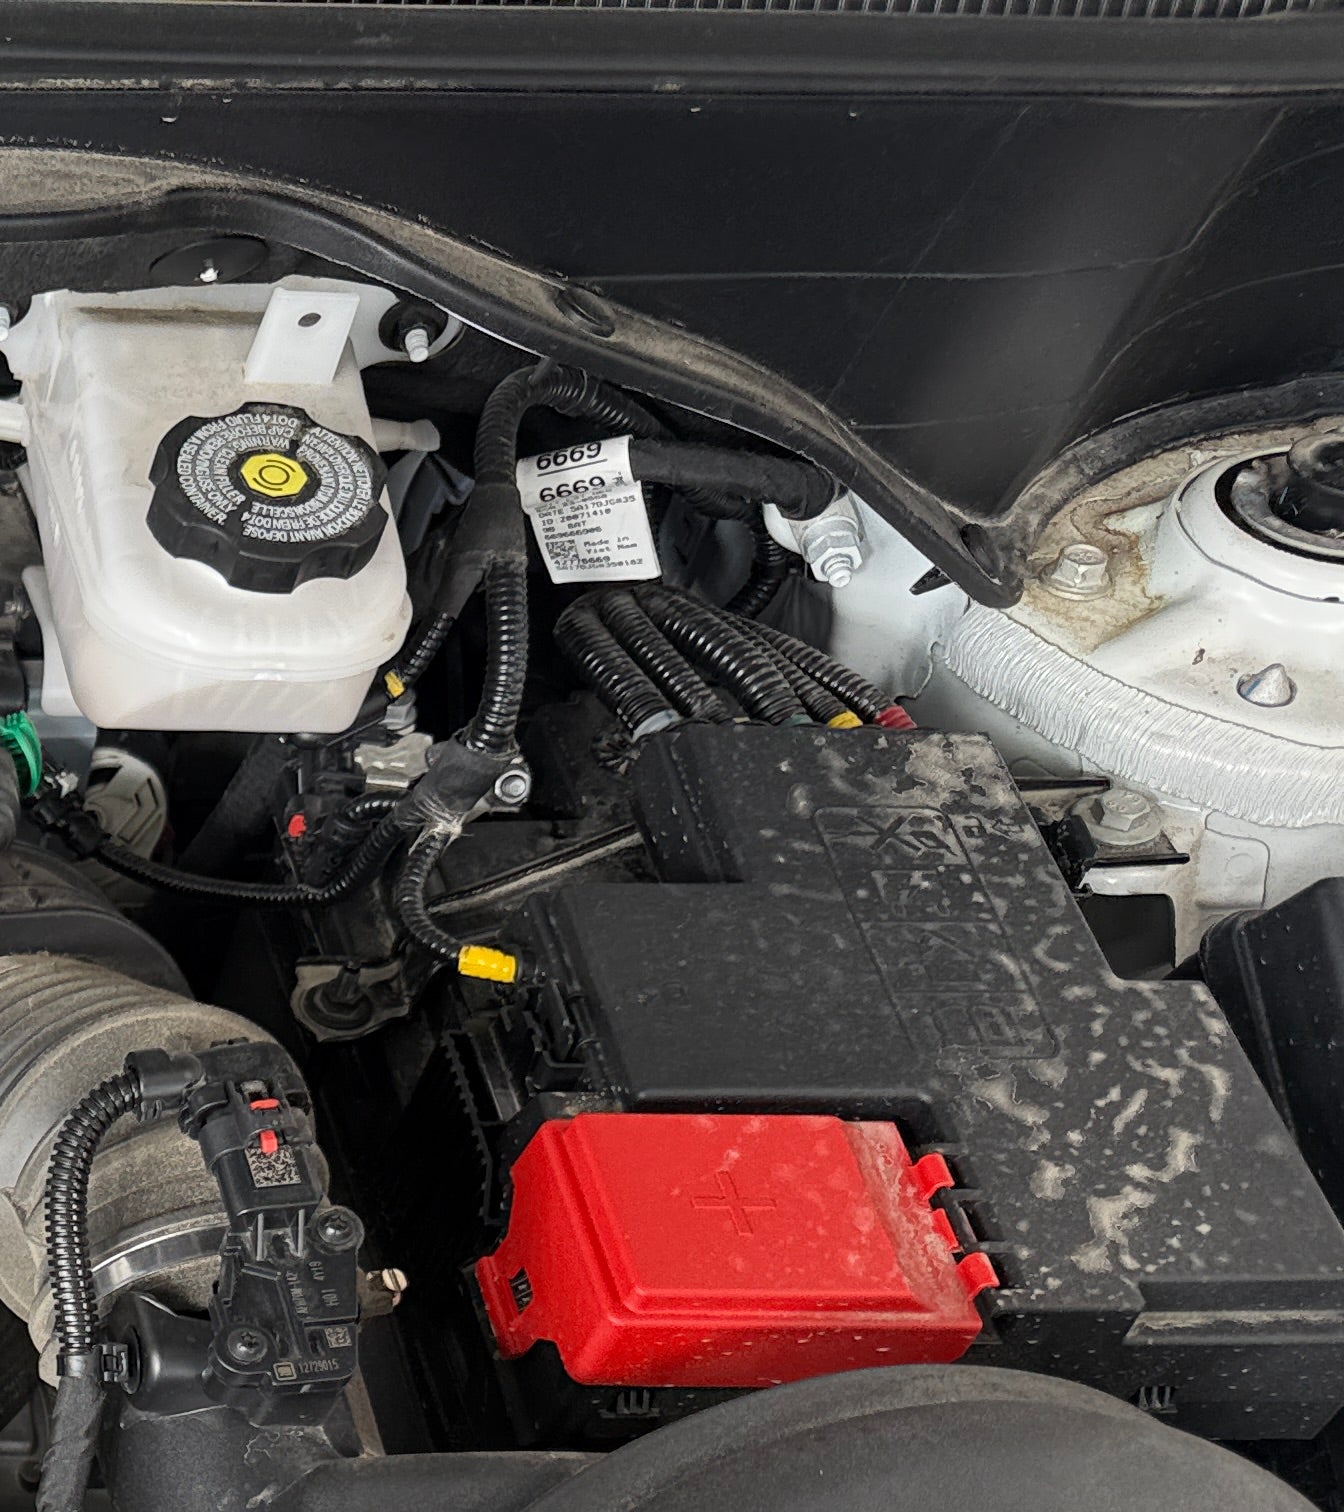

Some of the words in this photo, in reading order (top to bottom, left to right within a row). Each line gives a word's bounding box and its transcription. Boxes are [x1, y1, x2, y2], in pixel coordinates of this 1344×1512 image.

[225, 414, 260, 426] FLUID
[261, 414, 271, 423] 4
[273, 414, 300, 427] DOT
[193, 420, 227, 440] FROM
[221, 424, 266, 440] BEFORE
[268, 425, 294, 438] CAP
[187, 436, 201, 444] A
[536, 441, 602, 470] 6669
[196, 476, 216, 492] USE
[214, 476, 246, 505] FILLER
[539, 476, 605, 502] 6669
[208, 491, 237, 512] ONLY
[240, 512, 252, 521] 4
[251, 514, 272, 528] DOT
[272, 518, 306, 530] FREIN
[289, 527, 325, 542] AVANT
